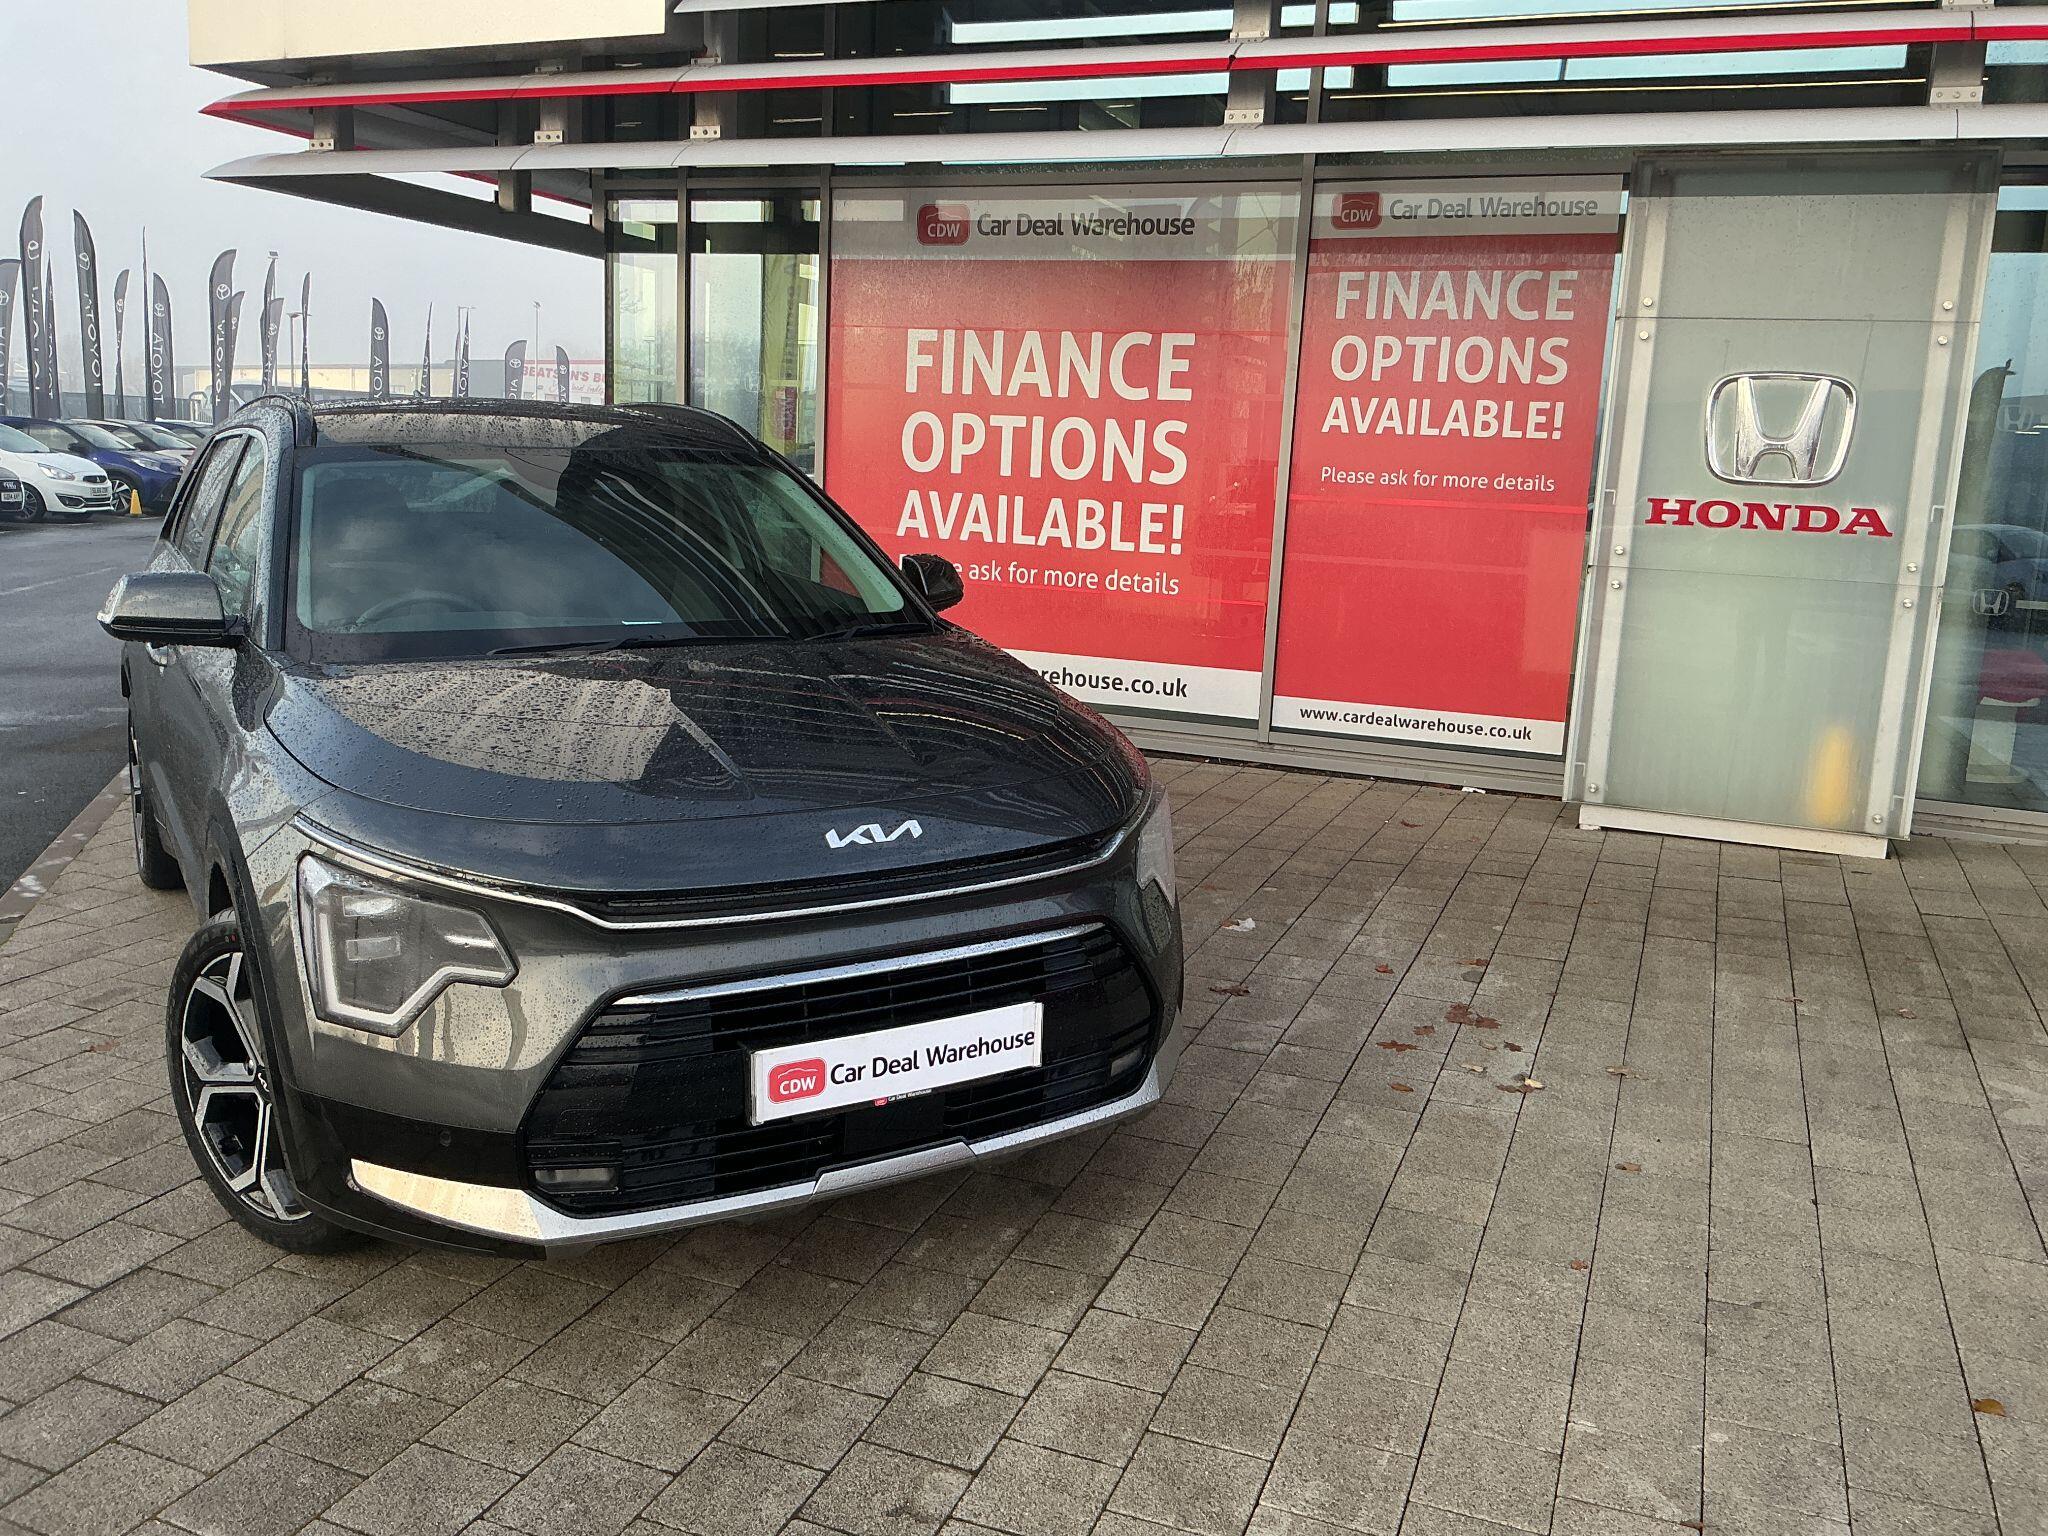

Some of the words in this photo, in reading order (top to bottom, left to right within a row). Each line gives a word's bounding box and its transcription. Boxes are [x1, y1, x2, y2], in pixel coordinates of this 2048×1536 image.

[976, 213, 1012, 236] Car
[1016, 212, 1064, 236] Deal
[1071, 211, 1196, 236] Warehouse
[1341, 209, 1373, 224] CDW
[1390, 199, 1422, 220] Car
[1427, 197, 1472, 219] Deal
[1480, 196, 1598, 218] Warehouse
[926, 221, 961, 239] CDW
[1335, 269, 1579, 322] FINANCE
[523, 365, 589, 381] BEATSN'S
[904, 327, 1197, 402] FINANCE
[1330, 334, 1570, 385] OPTIONS
[1320, 396, 1565, 441] AVAILABLE!
[901, 411, 1189, 486] OPTIONS
[1321, 467, 1375, 484] Please
[1379, 469, 1407, 486] ask
[1413, 469, 1438, 487] for
[1442, 474, 1488, 489] more
[1493, 473, 1555, 492] details
[896, 489, 1185, 555] AVAILABLE!
[1645, 497, 1893, 538] HONDA
[968, 561, 1002, 583] ask
[1008, 561, 1037, 584] for
[1043, 570, 1099, 590] more
[1105, 569, 1179, 595] details
[1034, 667, 1188, 698] rehouse.co.uk
[1299, 706, 1532, 741] www.cardealwarehouse.co.uk
[830, 1063, 866, 1085] Car
[872, 1050, 919, 1078] Deal
[926, 1031, 1036, 1067] Warehouse
[779, 1076, 817, 1096] CDW
